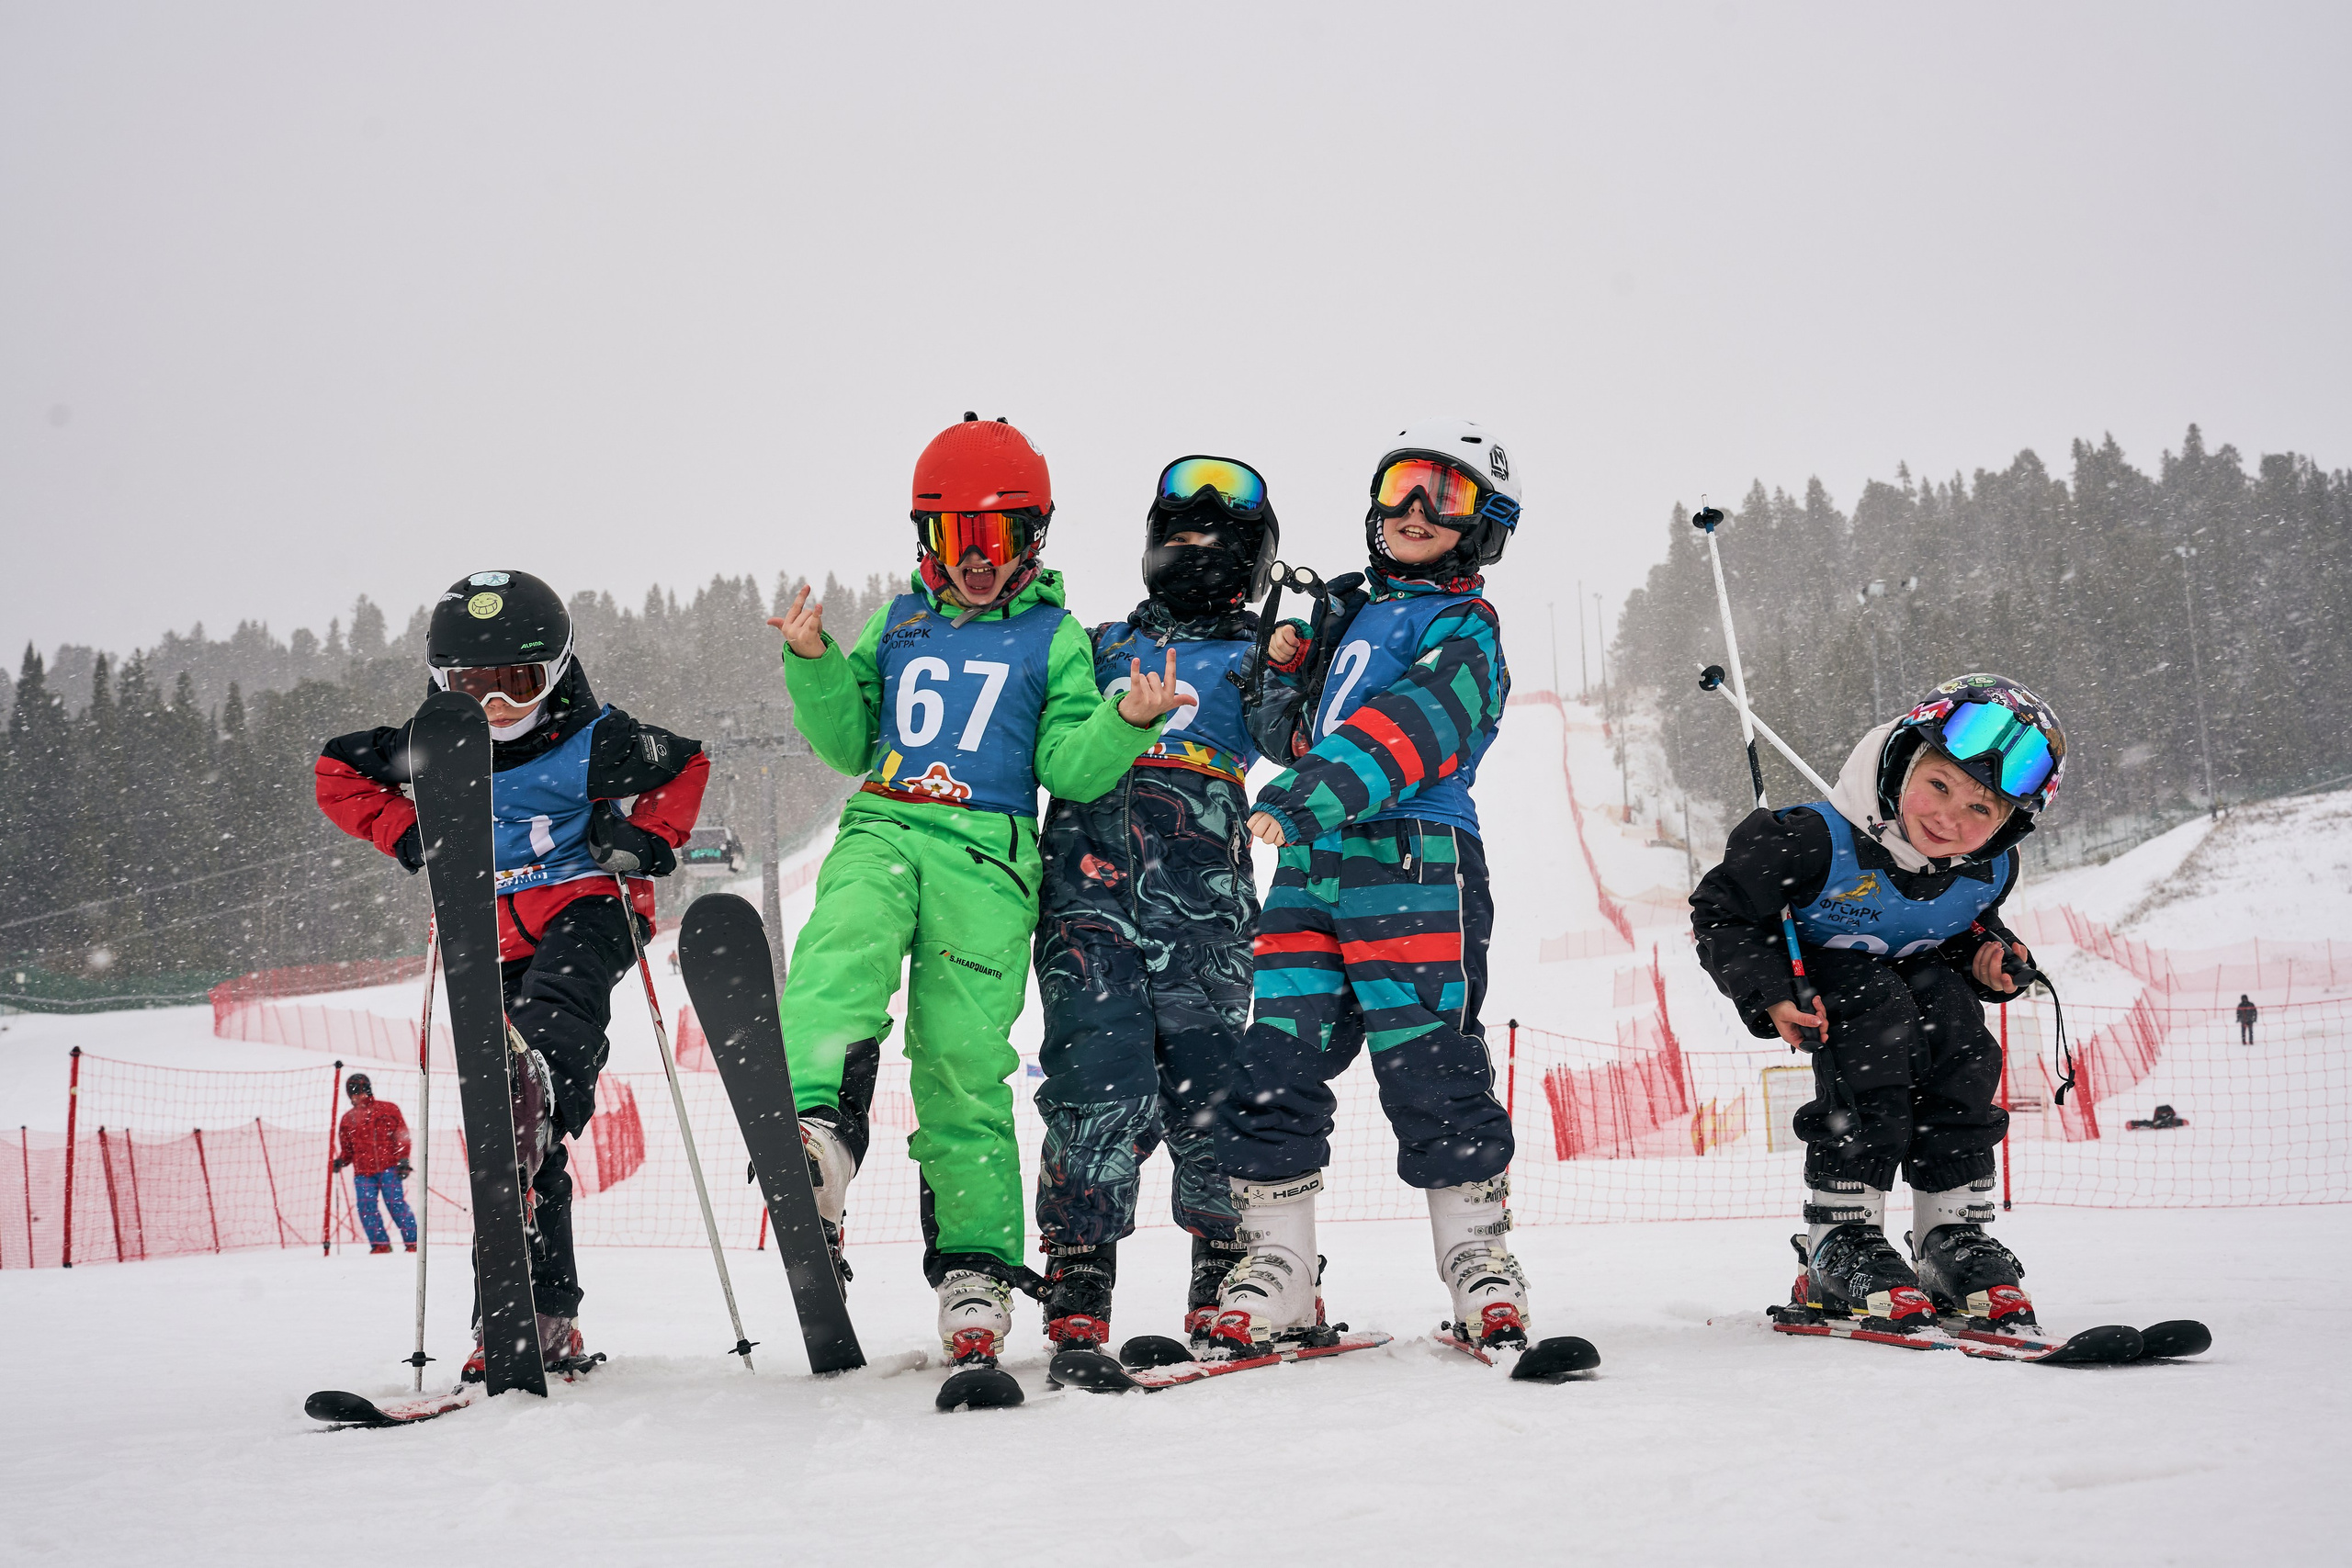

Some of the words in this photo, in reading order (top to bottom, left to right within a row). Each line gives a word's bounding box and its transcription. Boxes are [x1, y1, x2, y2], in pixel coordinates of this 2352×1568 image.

[1312, 640, 1372, 742] 2
[896, 657, 1010, 751] 67
[1819, 898, 1883, 922] ФГСиРК
[1827, 913, 1860, 928] ЮГРА
[1272, 1179, 1319, 1200] HEAD
